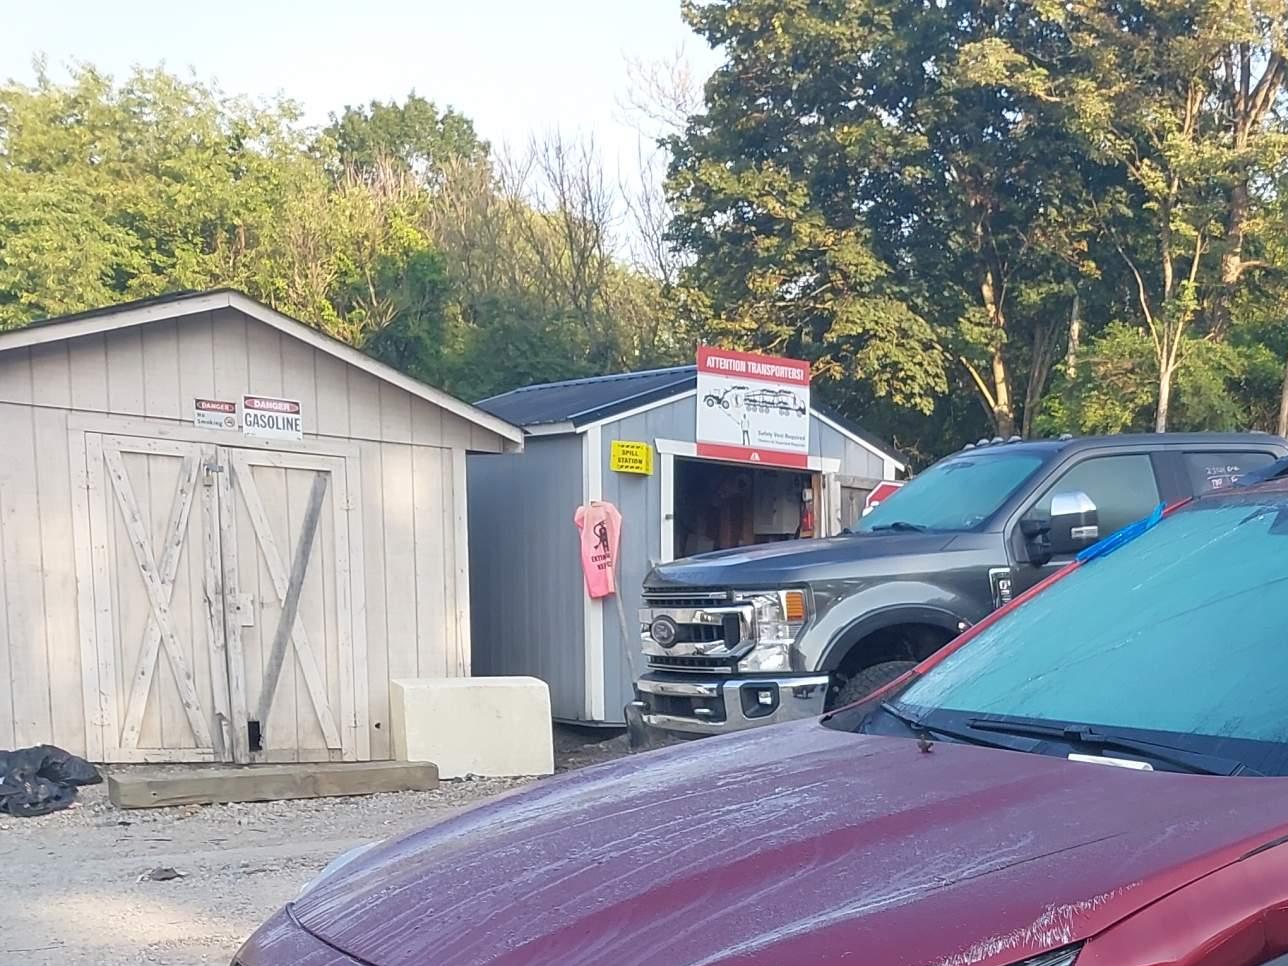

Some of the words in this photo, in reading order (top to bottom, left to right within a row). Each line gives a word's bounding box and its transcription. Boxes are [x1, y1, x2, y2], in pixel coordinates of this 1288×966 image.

[706, 356, 746, 372] ATTENTION
[747, 361, 804, 380] TRANSPORTERS!
[201, 401, 230, 411] DANGER
[254, 399, 291, 412] DANGER
[244, 412, 301, 432] GASOLINE
[622, 449, 639, 457] SPILL
[617, 457, 643, 465] STATION
